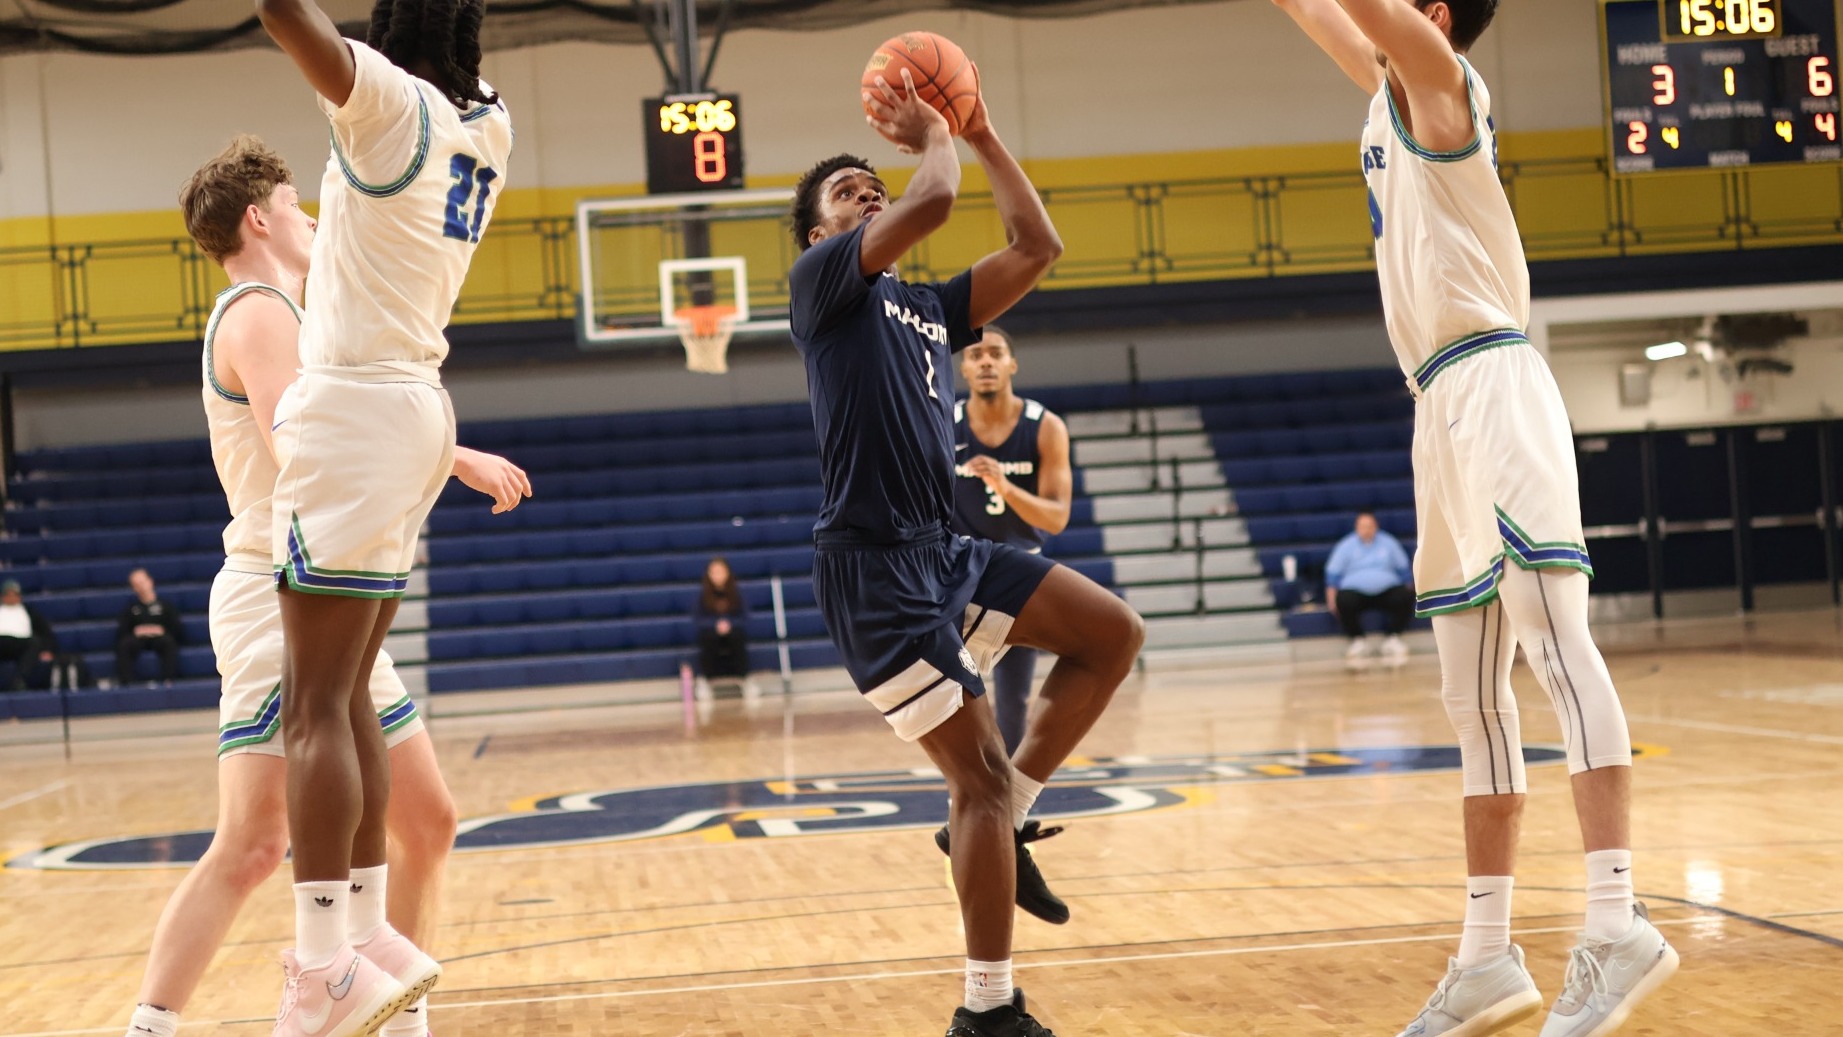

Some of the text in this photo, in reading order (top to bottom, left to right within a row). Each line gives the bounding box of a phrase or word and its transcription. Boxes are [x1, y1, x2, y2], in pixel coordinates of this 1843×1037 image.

[1680, 0, 1775, 36] 15:06
[1652, 64, 1675, 105] 3
[1723, 66, 1735, 96] 1
[1807, 56, 1833, 96] 6
[660, 100, 736, 134] 15:06
[1775, 120, 1793, 142] 4
[1814, 113, 1836, 141] 4
[1627, 120, 1648, 154] 2
[1661, 126, 1680, 149] 4
[693, 132, 727, 182] 8
[443, 152, 498, 244] 21
[924, 349, 939, 399] 1
[985, 485, 1006, 516] 3
